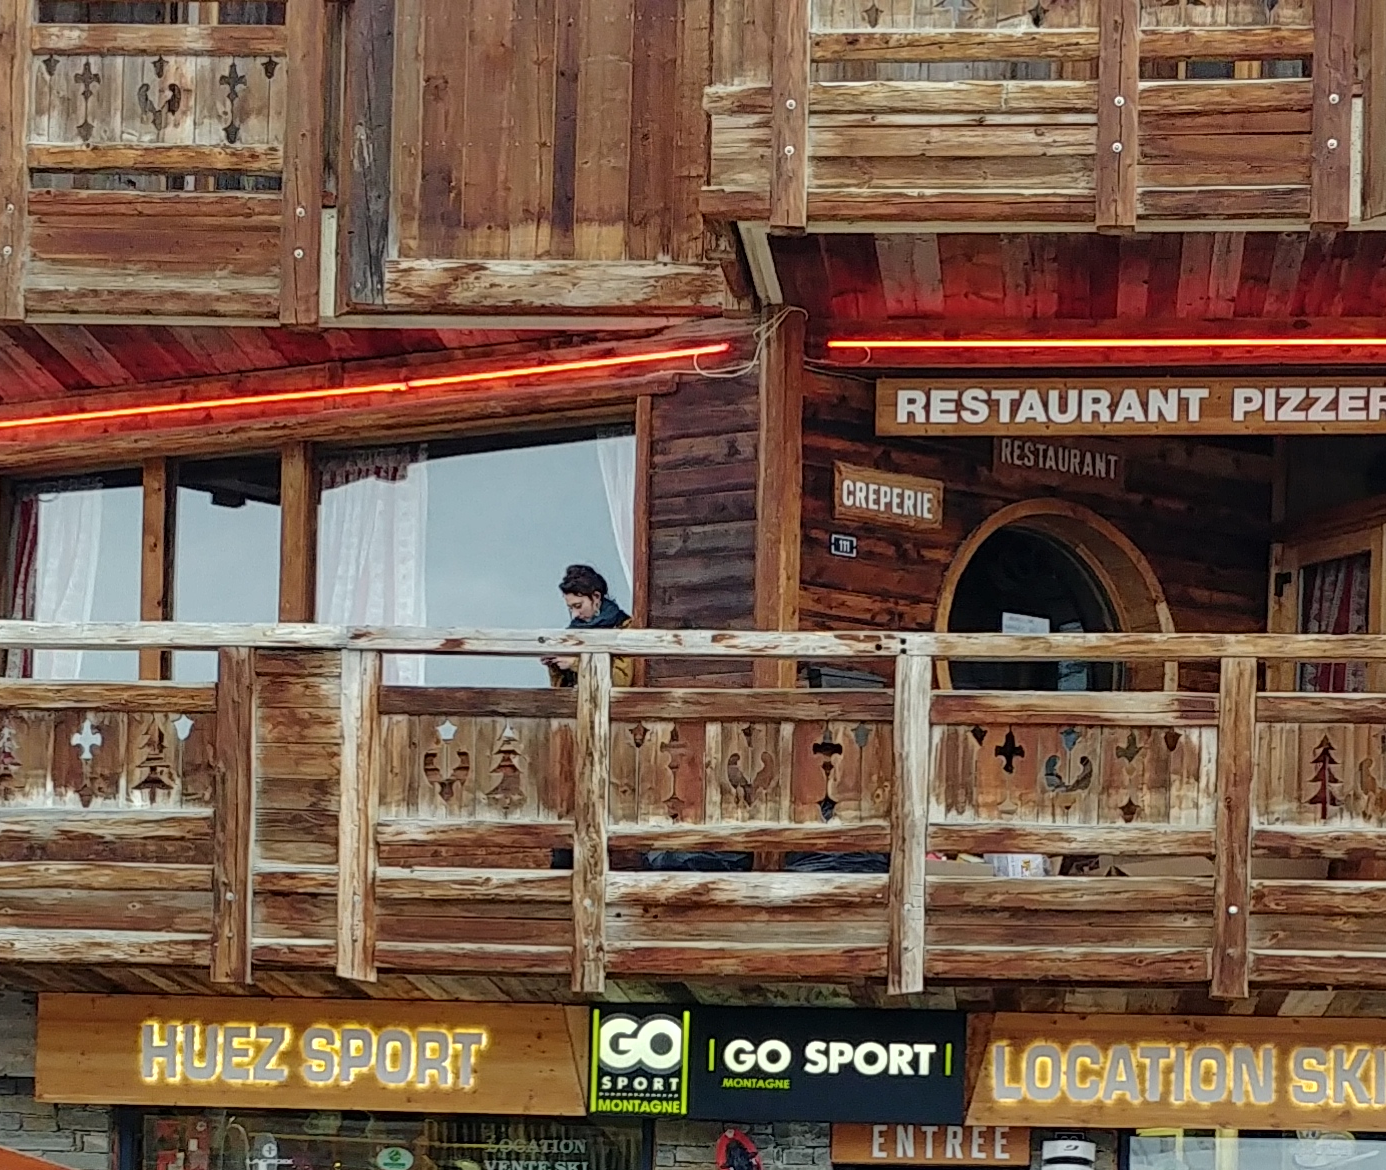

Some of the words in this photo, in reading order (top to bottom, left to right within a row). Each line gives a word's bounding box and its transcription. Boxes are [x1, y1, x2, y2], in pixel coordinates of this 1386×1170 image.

[897, 387, 1210, 424] RESTAURANT
[1000, 438, 1119, 481] RESTAURANT
[841, 478, 934, 522] CREPERIE
[838, 539, 851, 552] 111
[141, 1022, 290, 1082] HUEZ
[300, 1025, 487, 1087] SPORT
[599, 1017, 683, 1069] GO
[723, 1039, 792, 1073] GO
[804, 1041, 937, 1076] SPORT
[601, 1075, 680, 1091] SPORT
[722, 1078, 791, 1090] MONTAGNE
[993, 1043, 1275, 1105] LOCATION
[1291, 1048, 1386, 1106] SKI
[597, 1099, 681, 1115] MONTAGNE
[484, 1138, 588, 1154] LOCATION
[871, 1124, 1011, 1160] ENTREE
